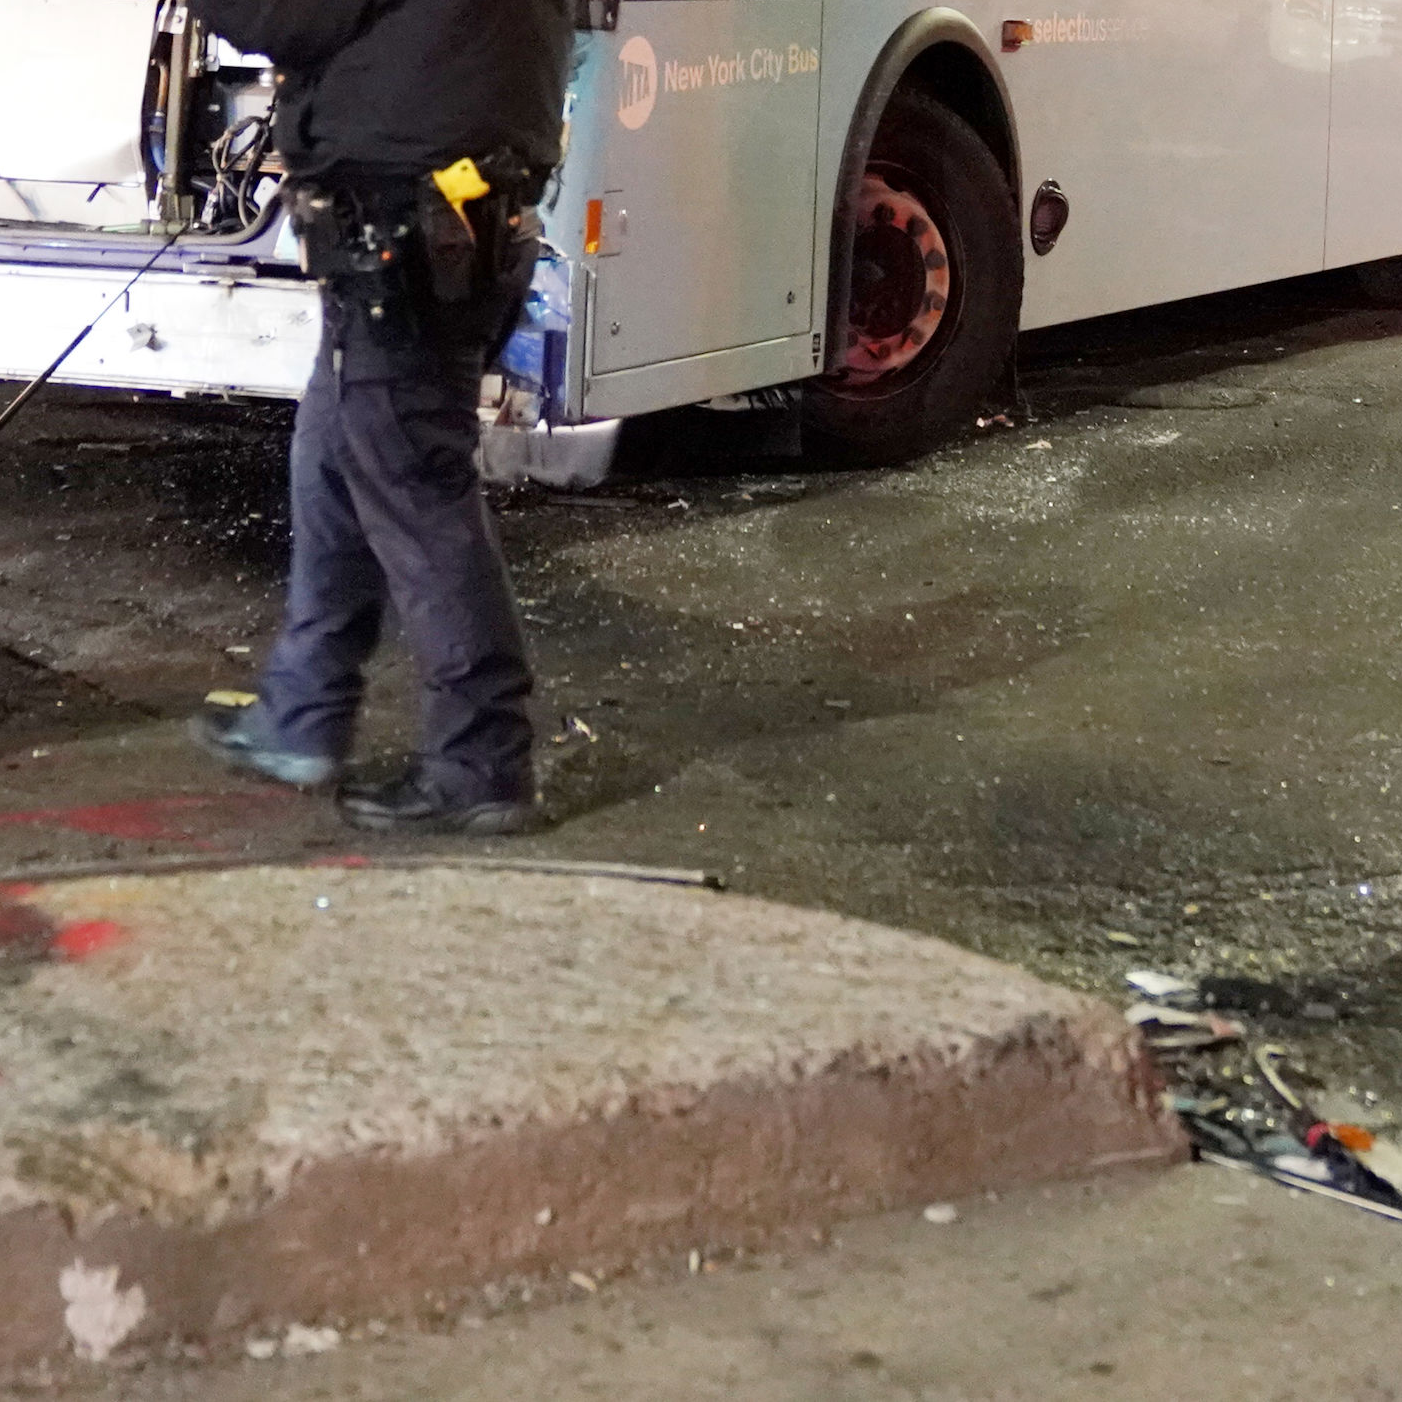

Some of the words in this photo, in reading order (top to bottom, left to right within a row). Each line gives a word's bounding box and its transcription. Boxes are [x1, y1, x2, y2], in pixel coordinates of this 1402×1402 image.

[664, 58, 704, 93] New
[707, 51, 747, 86] York
[750, 46, 784, 84] City
[787, 42, 818, 75] Bus
